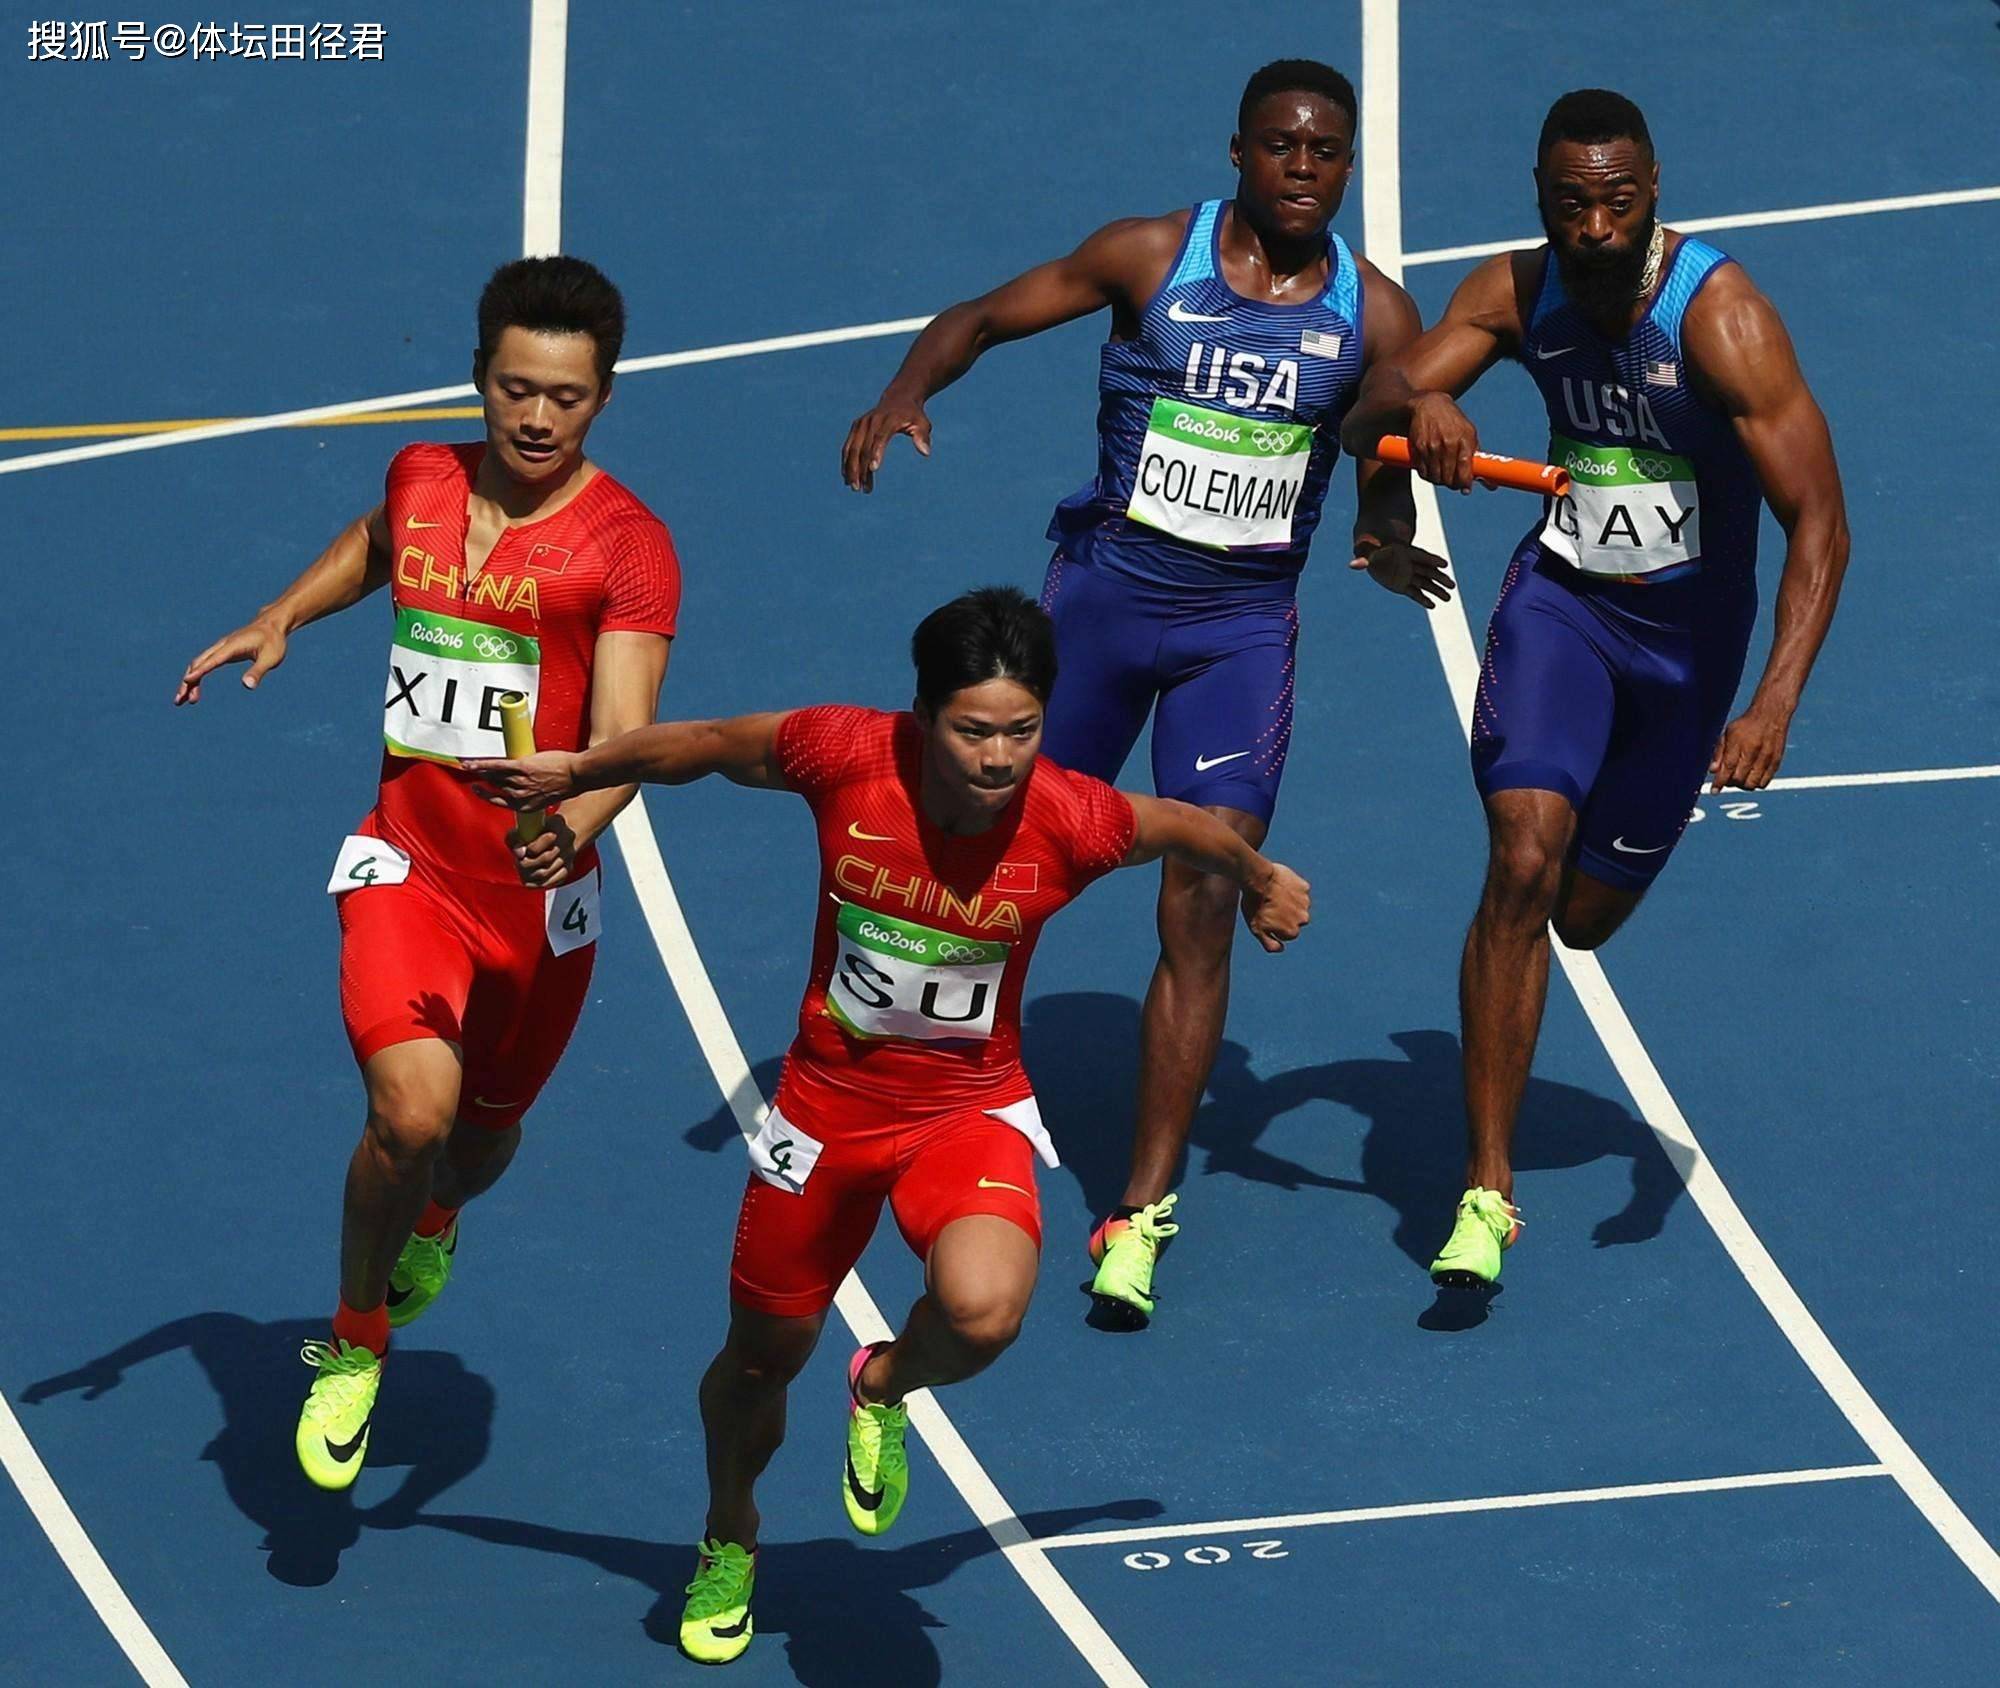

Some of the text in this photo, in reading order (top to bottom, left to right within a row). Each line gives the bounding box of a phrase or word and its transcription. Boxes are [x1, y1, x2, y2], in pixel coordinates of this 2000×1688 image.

[1183, 341, 1299, 412] USA
[1562, 377, 1672, 450] USA
[1141, 453, 1299, 520] COLEMAN
[1554, 493, 1696, 547] GAY
[348, 856, 379, 886] 4
[834, 854, 1023, 935] CHINA
[562, 897, 588, 935] 4
[839, 953, 990, 1022] SU
[769, 1139, 793, 1175] 4
[1123, 1540, 1289, 1570] 200
